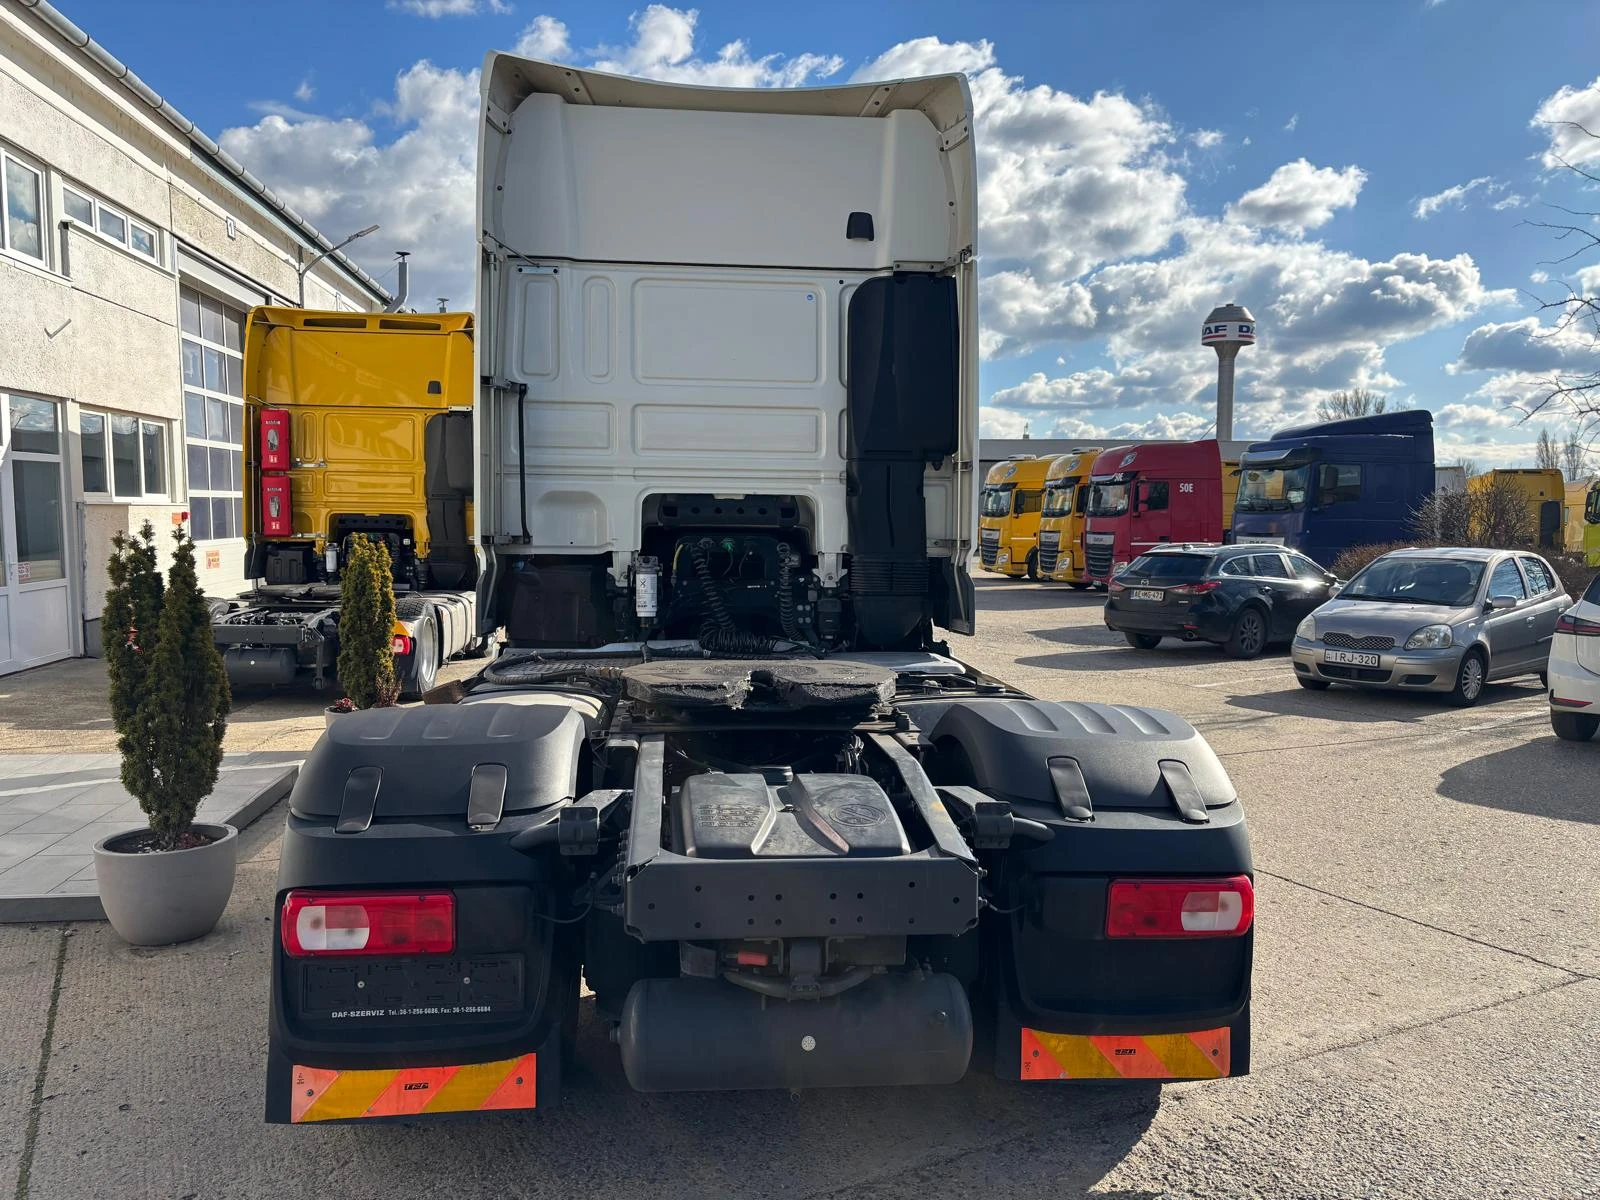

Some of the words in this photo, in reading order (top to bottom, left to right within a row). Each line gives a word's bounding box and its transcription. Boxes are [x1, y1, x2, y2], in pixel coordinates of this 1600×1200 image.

[1203, 325, 1228, 335] AF
[1335, 652, 1377, 665] IRJ-320
[331, 1009, 385, 1018] DAF-SZERVIZ
